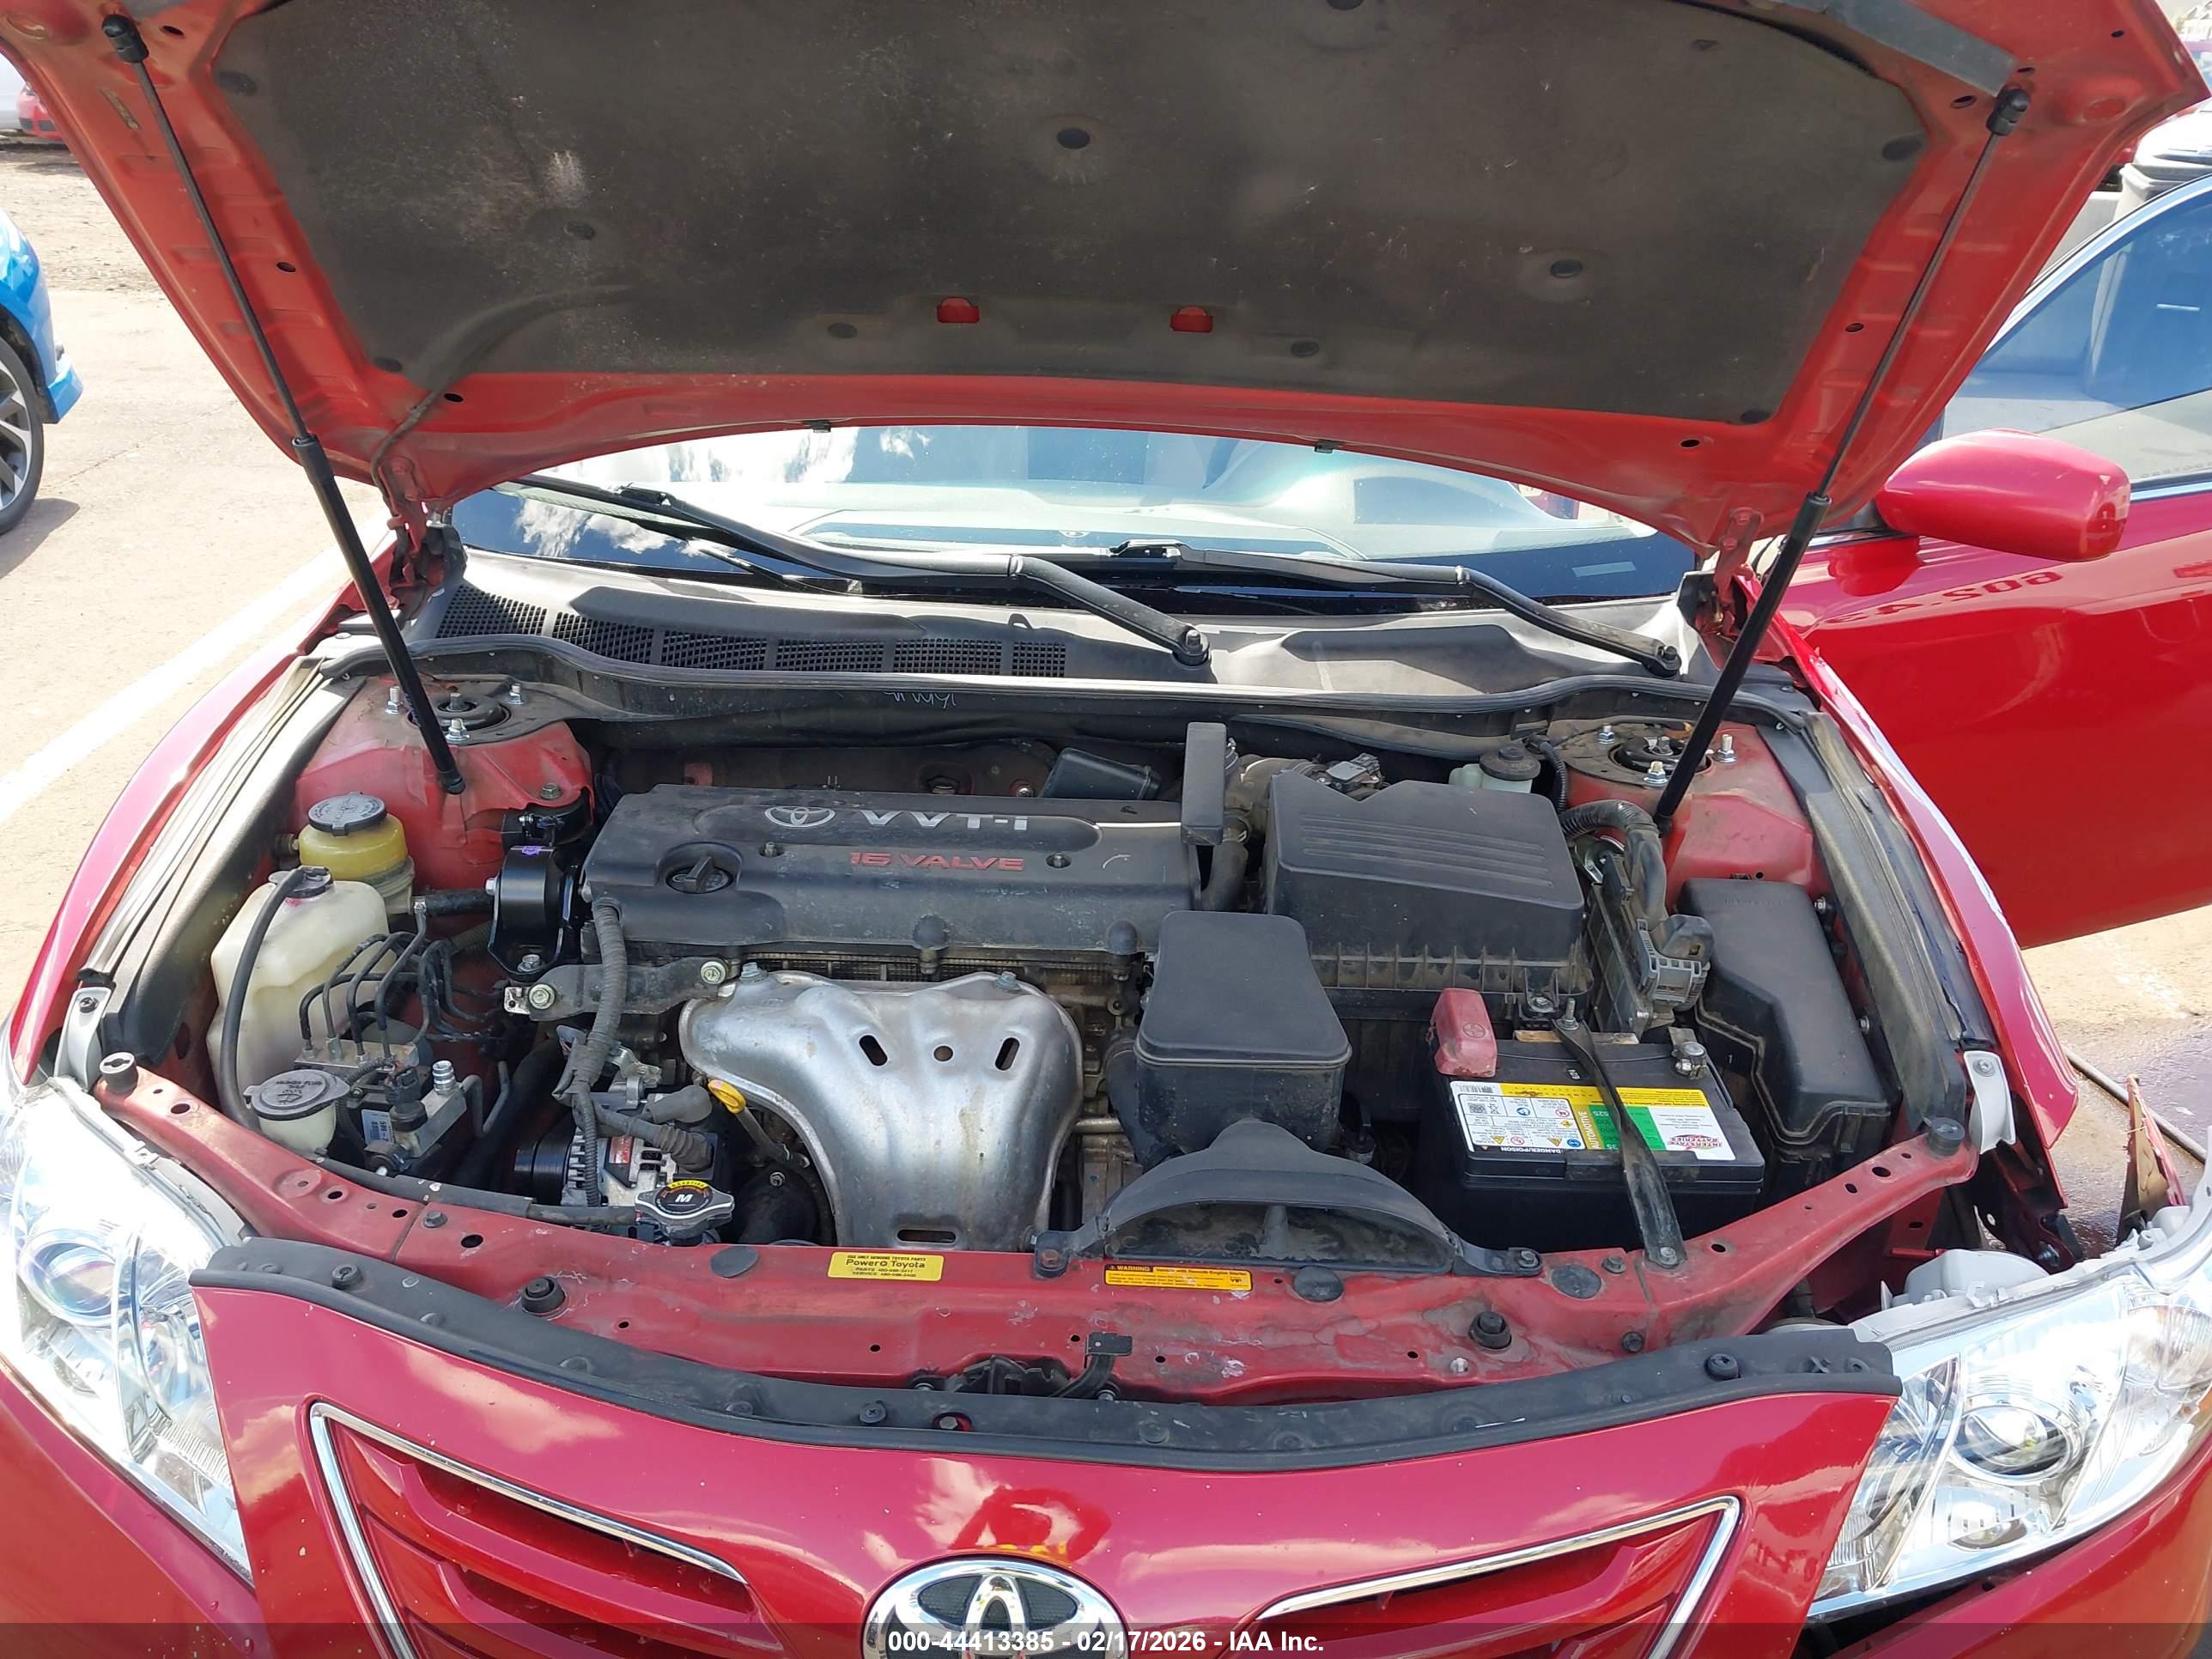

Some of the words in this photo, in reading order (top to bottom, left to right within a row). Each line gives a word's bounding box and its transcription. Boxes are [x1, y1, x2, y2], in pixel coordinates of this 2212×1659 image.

[849, 851, 891, 866] 16
[900, 853, 1024, 872] VALVE
[1578, 1110, 1601, 1150] AUTOMOTIVE
[674, 1194, 694, 1203] M
